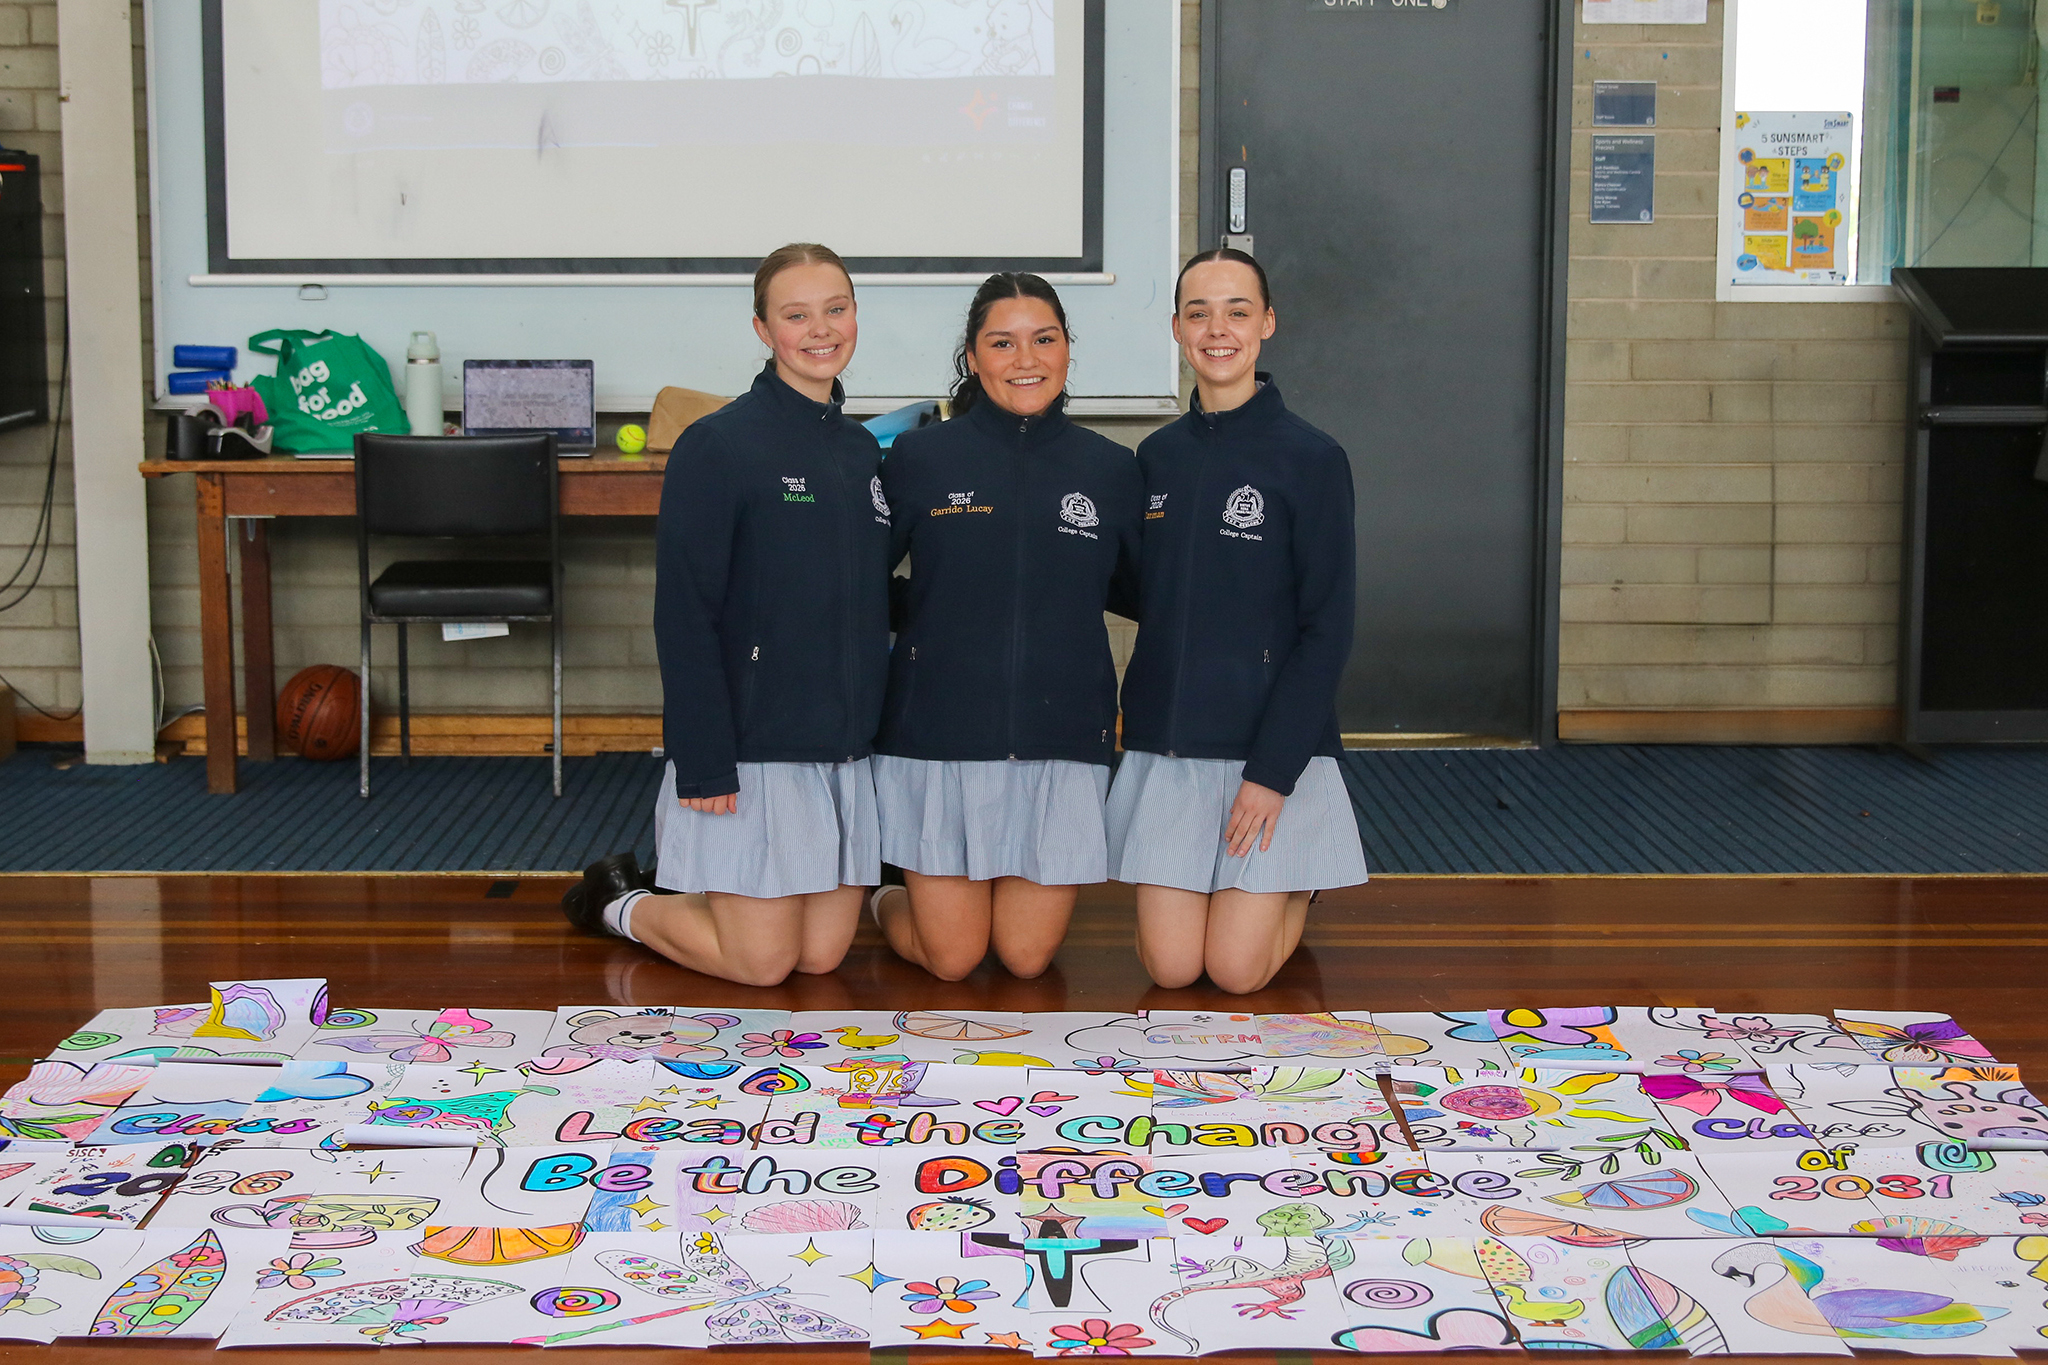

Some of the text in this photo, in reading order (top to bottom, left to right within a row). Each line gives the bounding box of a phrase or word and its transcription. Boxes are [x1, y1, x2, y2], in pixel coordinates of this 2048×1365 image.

[1762, 133, 1825, 143] 5 SUNSMART
[1778, 146, 1808, 156] STEPS
[290, 360, 330, 395] bag
[298, 386, 331, 414] for
[782, 476, 799, 484] Class
[788, 484, 806, 492] 2026
[783, 492, 815, 503] McLeod
[948, 492, 966, 500] Class
[951, 498, 971, 506] 2026
[930, 504, 994, 517] Garrido Lucay
[1057, 526, 1099, 540] College Captain
[1219, 528, 1263, 541] College Captain
[1146, 1033, 1263, 1045] CLTRM
[110, 1112, 321, 1135] Class
[1691, 1117, 1906, 1140] Class
[554, 1110, 1457, 1152] Lead the Change
[1795, 1142, 1860, 1172] of
[520, 1152, 1523, 1199] Be the Difference
[52, 1169, 295, 1197] 2026
[1768, 1173, 1954, 1200] 2031
